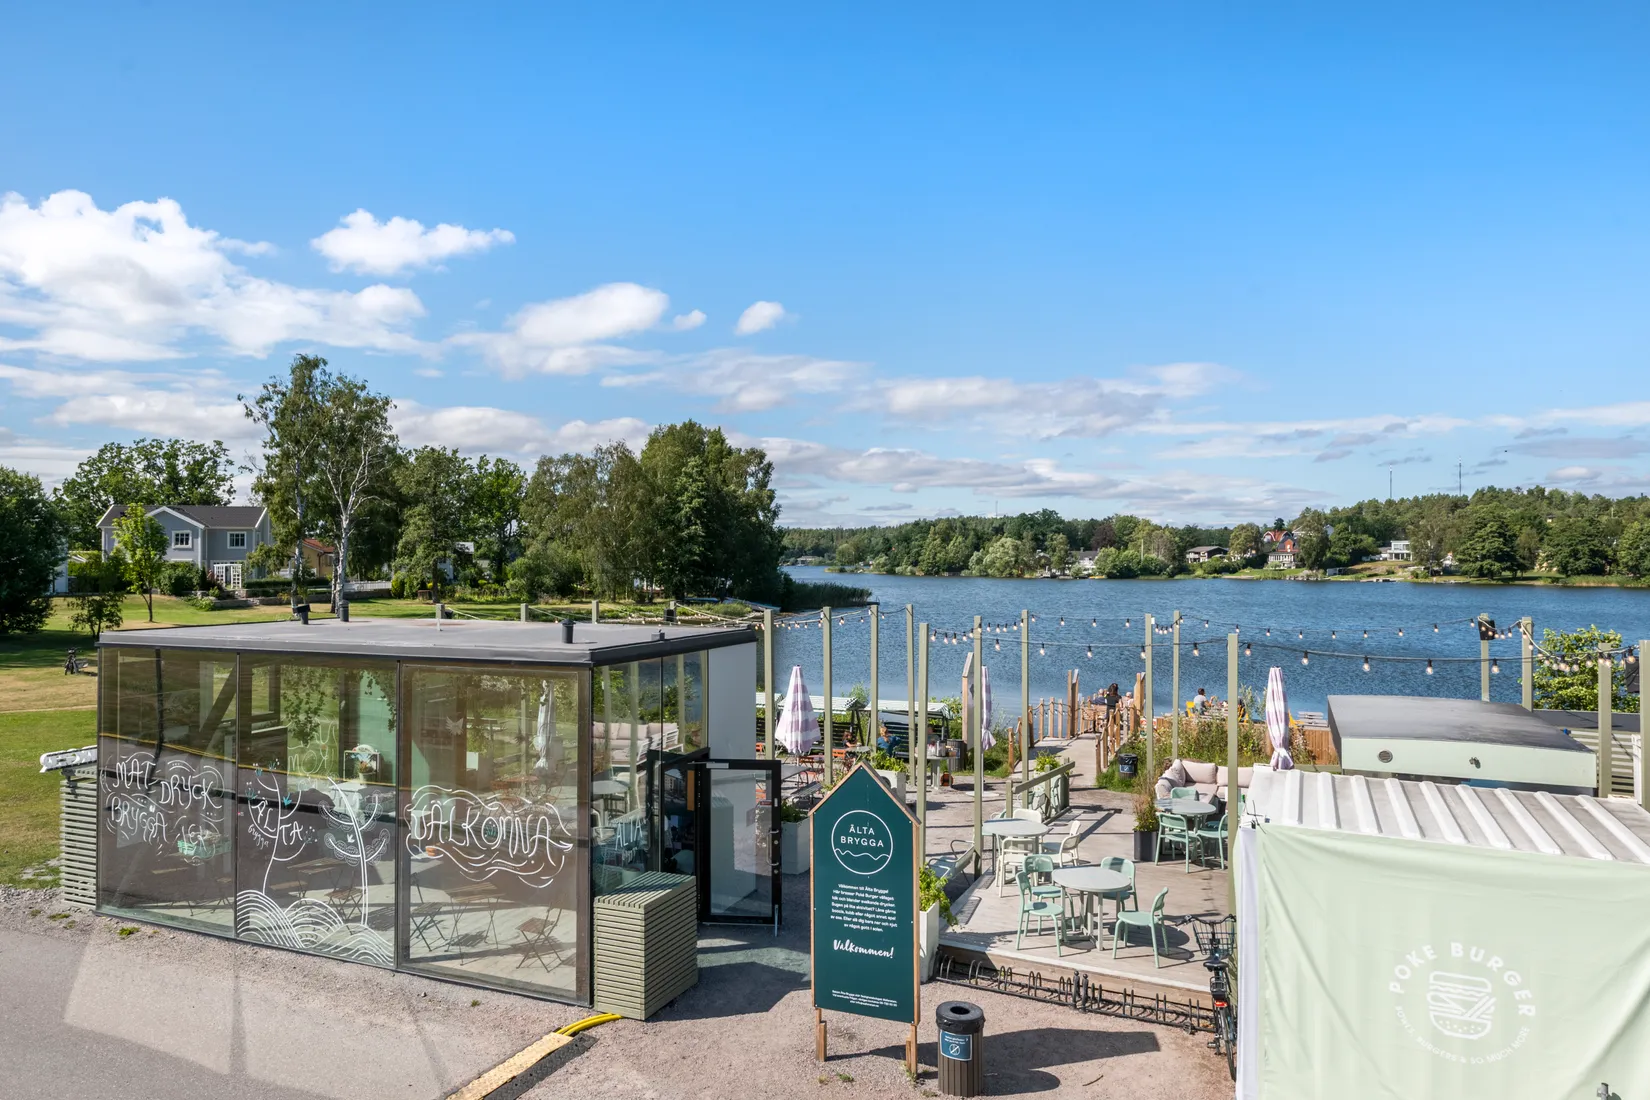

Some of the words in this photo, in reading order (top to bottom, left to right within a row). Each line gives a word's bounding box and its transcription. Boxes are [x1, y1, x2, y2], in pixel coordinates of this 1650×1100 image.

[112, 758, 157, 790] MAT
[159, 774, 222, 810] DRYCK
[840, 835, 884, 848] BRYGGA
[1388, 944, 1438, 994] POKE
[1450, 941, 1536, 1017] BURGER
[1470, 1056, 1484, 1064] SO
[1486, 1047, 1514, 1064] MUCH
[1510, 1025, 1531, 1050] MORE
